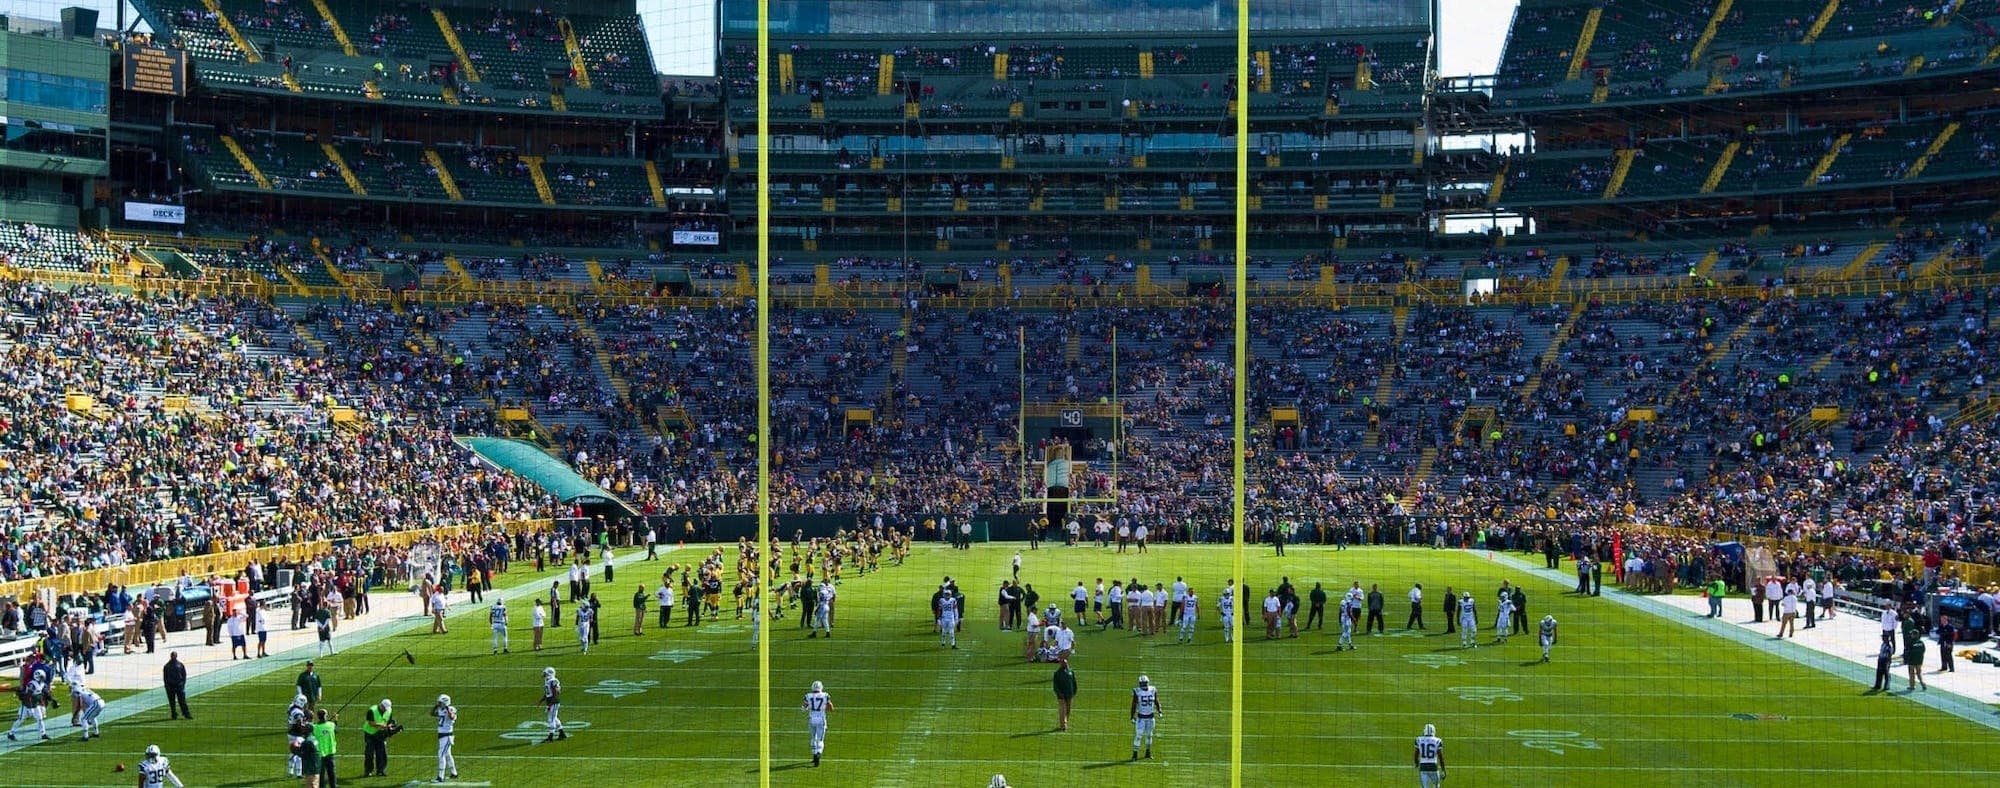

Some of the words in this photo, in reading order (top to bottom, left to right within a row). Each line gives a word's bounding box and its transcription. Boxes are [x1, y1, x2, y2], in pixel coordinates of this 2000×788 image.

[1063, 411, 1080, 425] 40
[810, 697, 824, 711] 17
[1420, 743, 1436, 759] 16
[149, 769, 164, 784] 39
